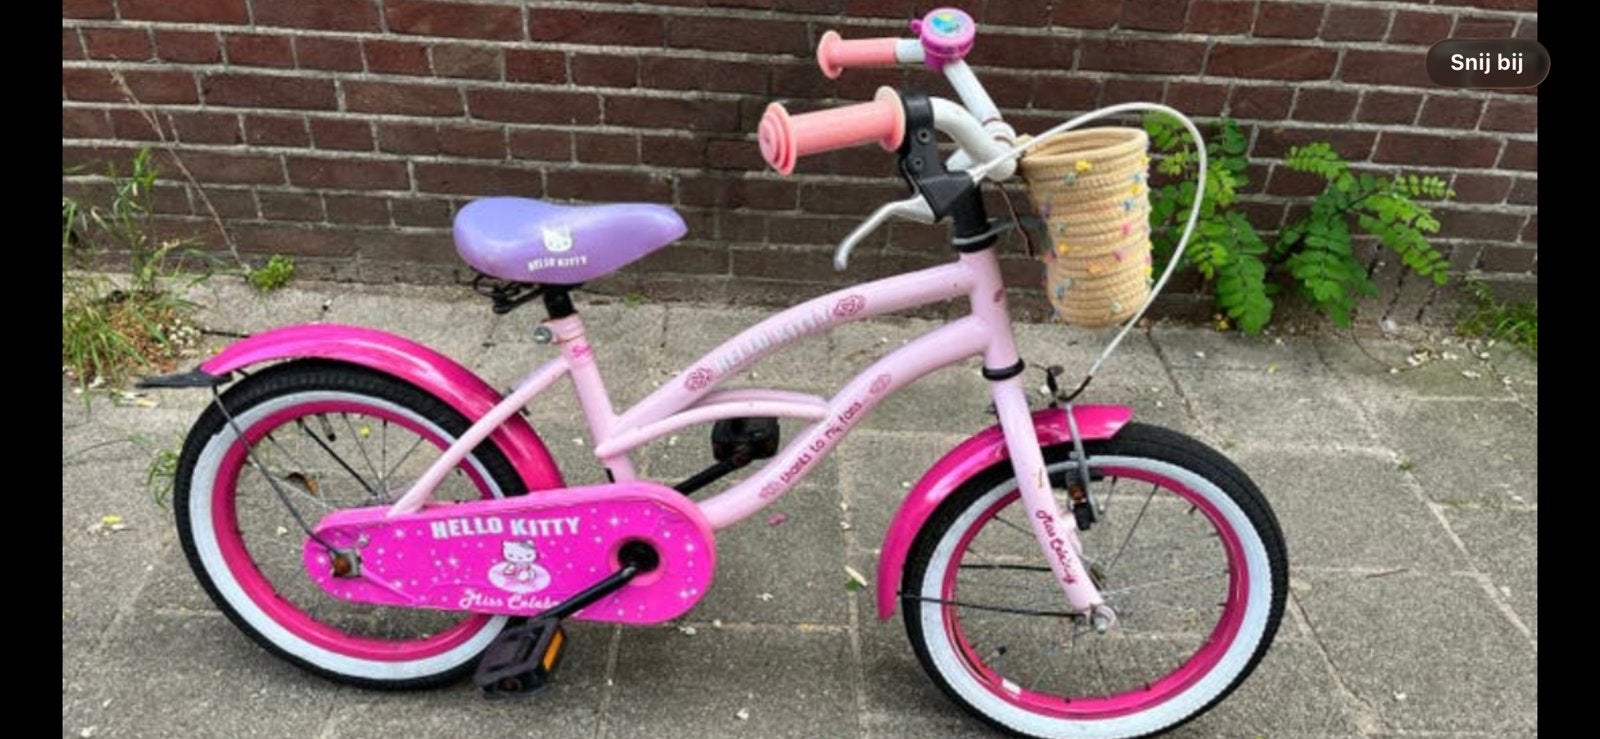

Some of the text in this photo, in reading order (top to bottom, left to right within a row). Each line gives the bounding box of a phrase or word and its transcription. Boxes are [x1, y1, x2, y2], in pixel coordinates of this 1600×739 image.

[810, 438, 826, 453] to
[430, 516, 580, 539] HELLO KITTY
[458, 587, 503, 610] Miss
